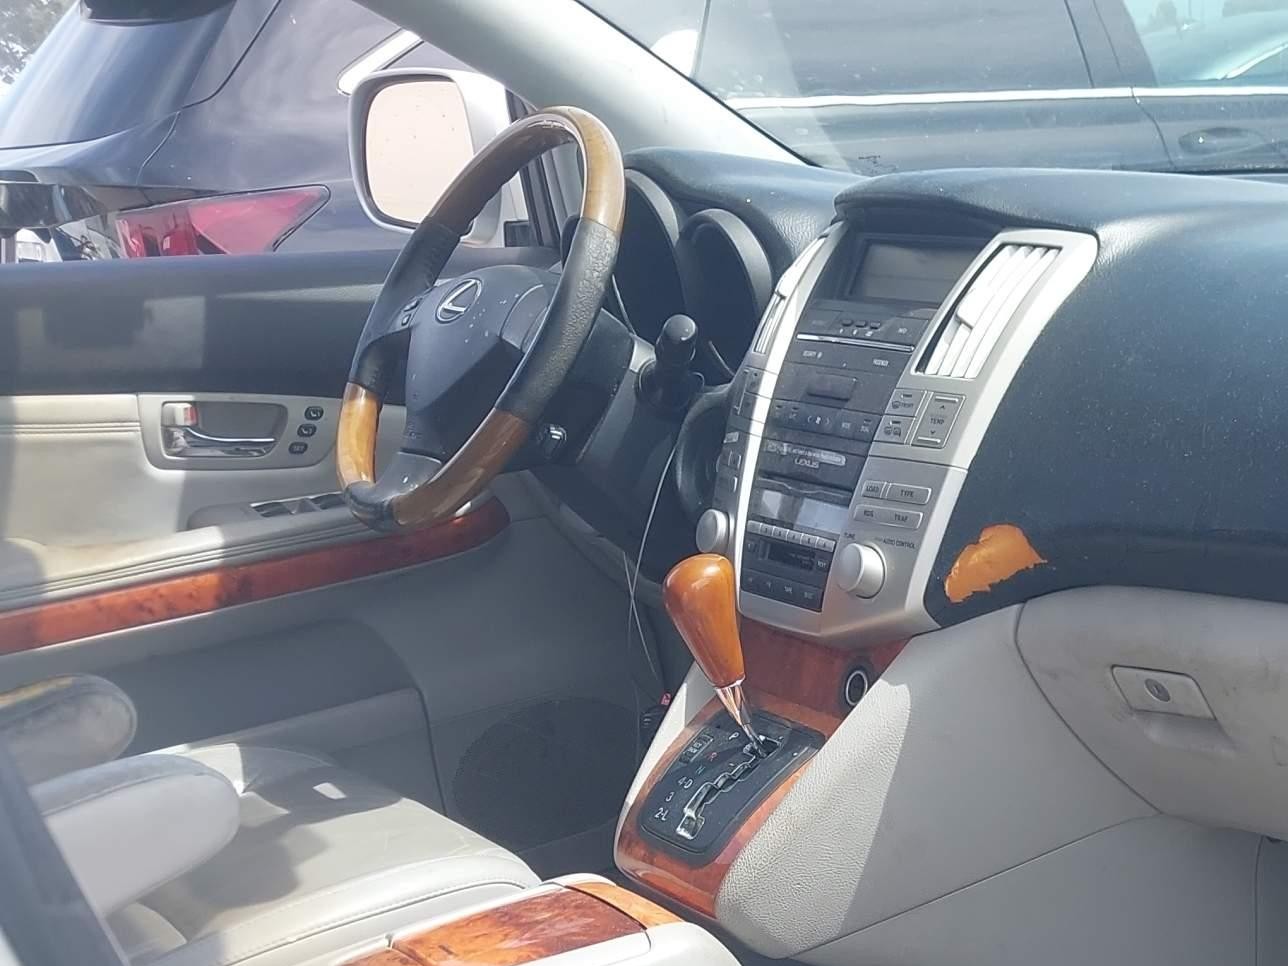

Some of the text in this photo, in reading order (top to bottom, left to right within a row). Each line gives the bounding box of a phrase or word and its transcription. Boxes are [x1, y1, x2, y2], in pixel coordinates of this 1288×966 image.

[729, 732, 739, 740] P
[708, 752, 717, 761] R
[666, 792, 674, 801] 3
[655, 808, 668, 821] 2-L
